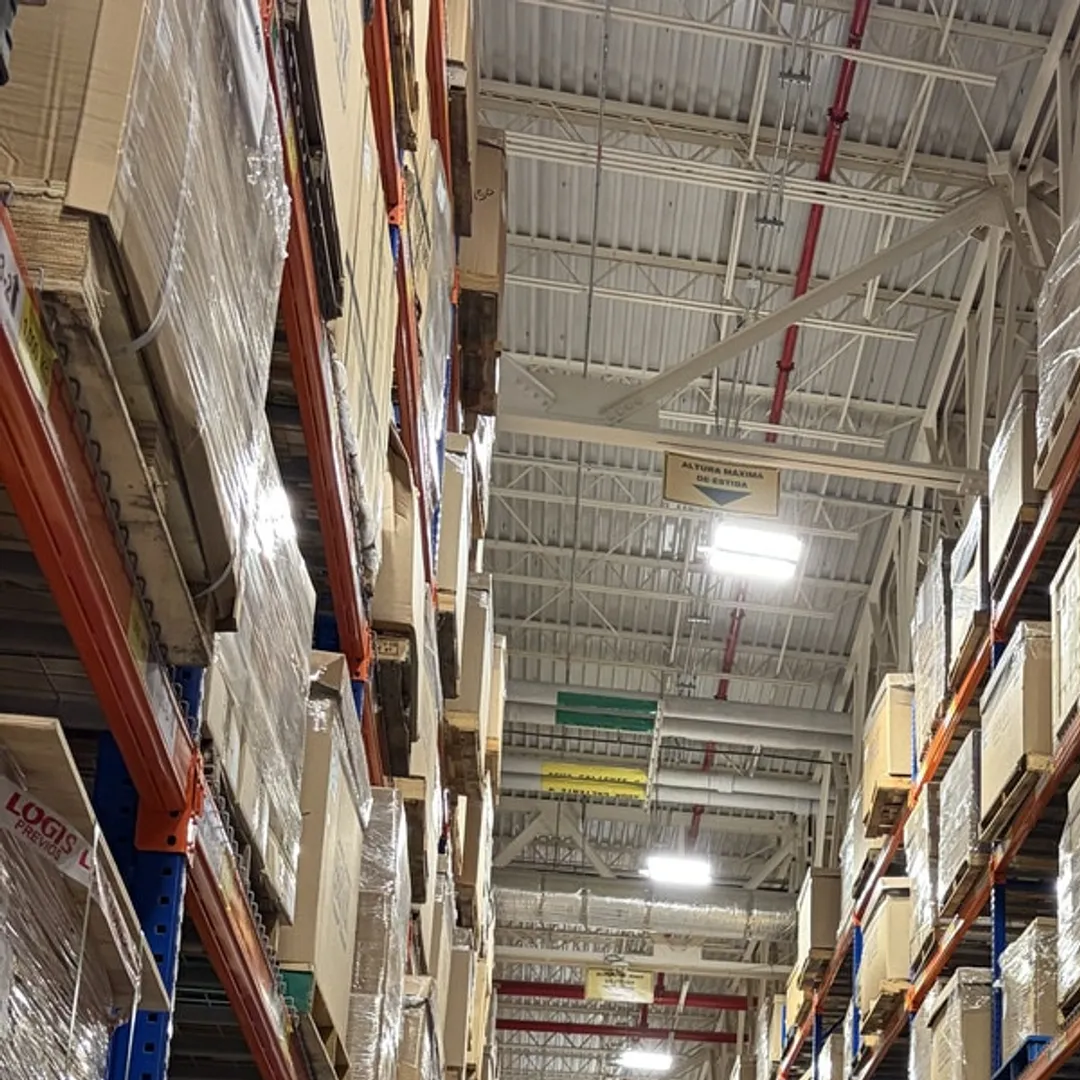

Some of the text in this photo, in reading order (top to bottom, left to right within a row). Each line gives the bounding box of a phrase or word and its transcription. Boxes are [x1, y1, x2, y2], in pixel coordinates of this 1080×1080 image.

[681, 461, 721, 474] ALTURA
[696, 475, 710, 483] DE
[5, 791, 77, 856] LOGIS
